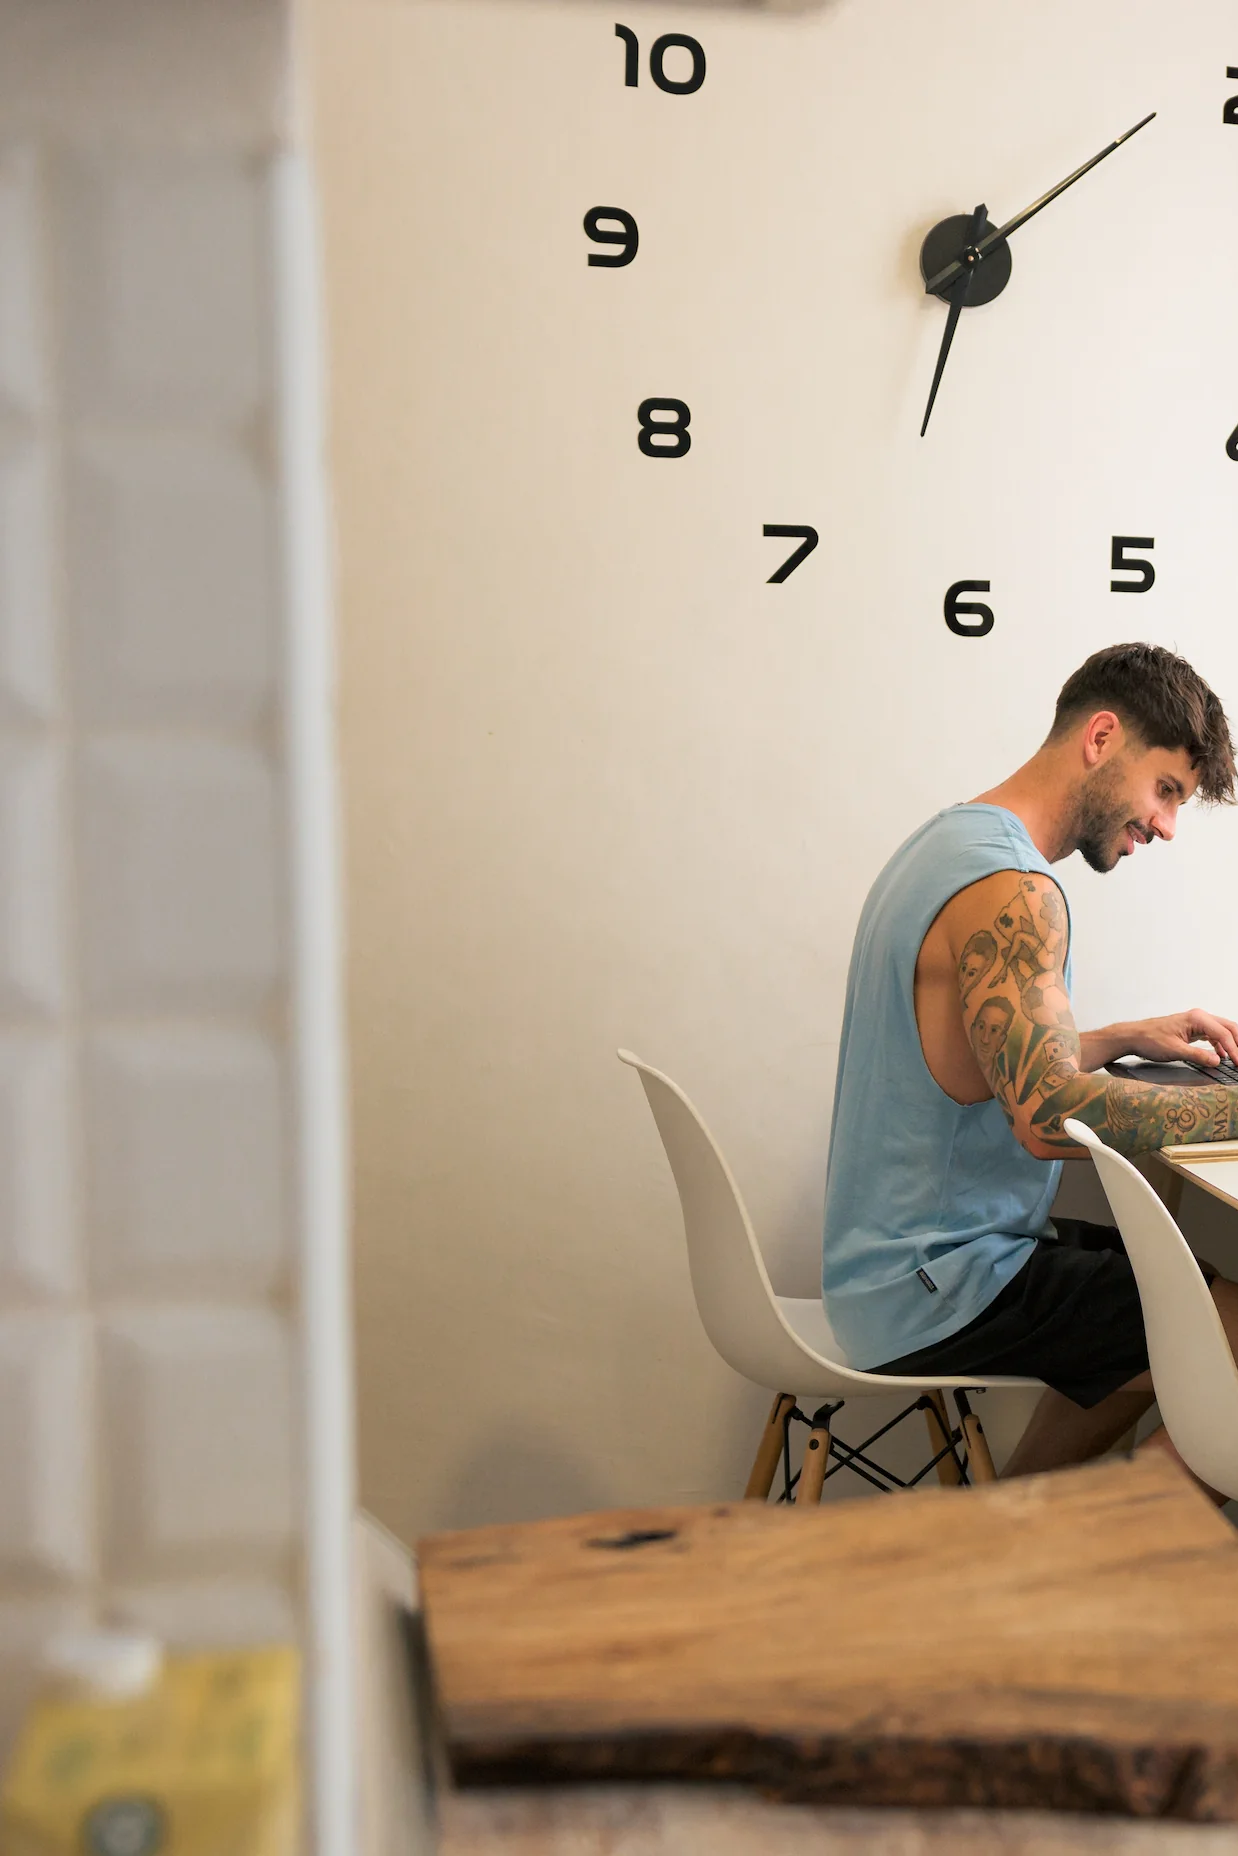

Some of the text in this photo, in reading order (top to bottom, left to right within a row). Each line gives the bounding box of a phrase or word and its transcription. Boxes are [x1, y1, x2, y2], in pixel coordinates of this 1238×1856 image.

[615, 24, 706, 95] 10
[583, 206, 639, 267] 9
[637, 398, 691, 458] 8
[762, 524, 818, 583] 7
[1110, 536, 1155, 593] 5
[944, 580, 994, 637] 6
